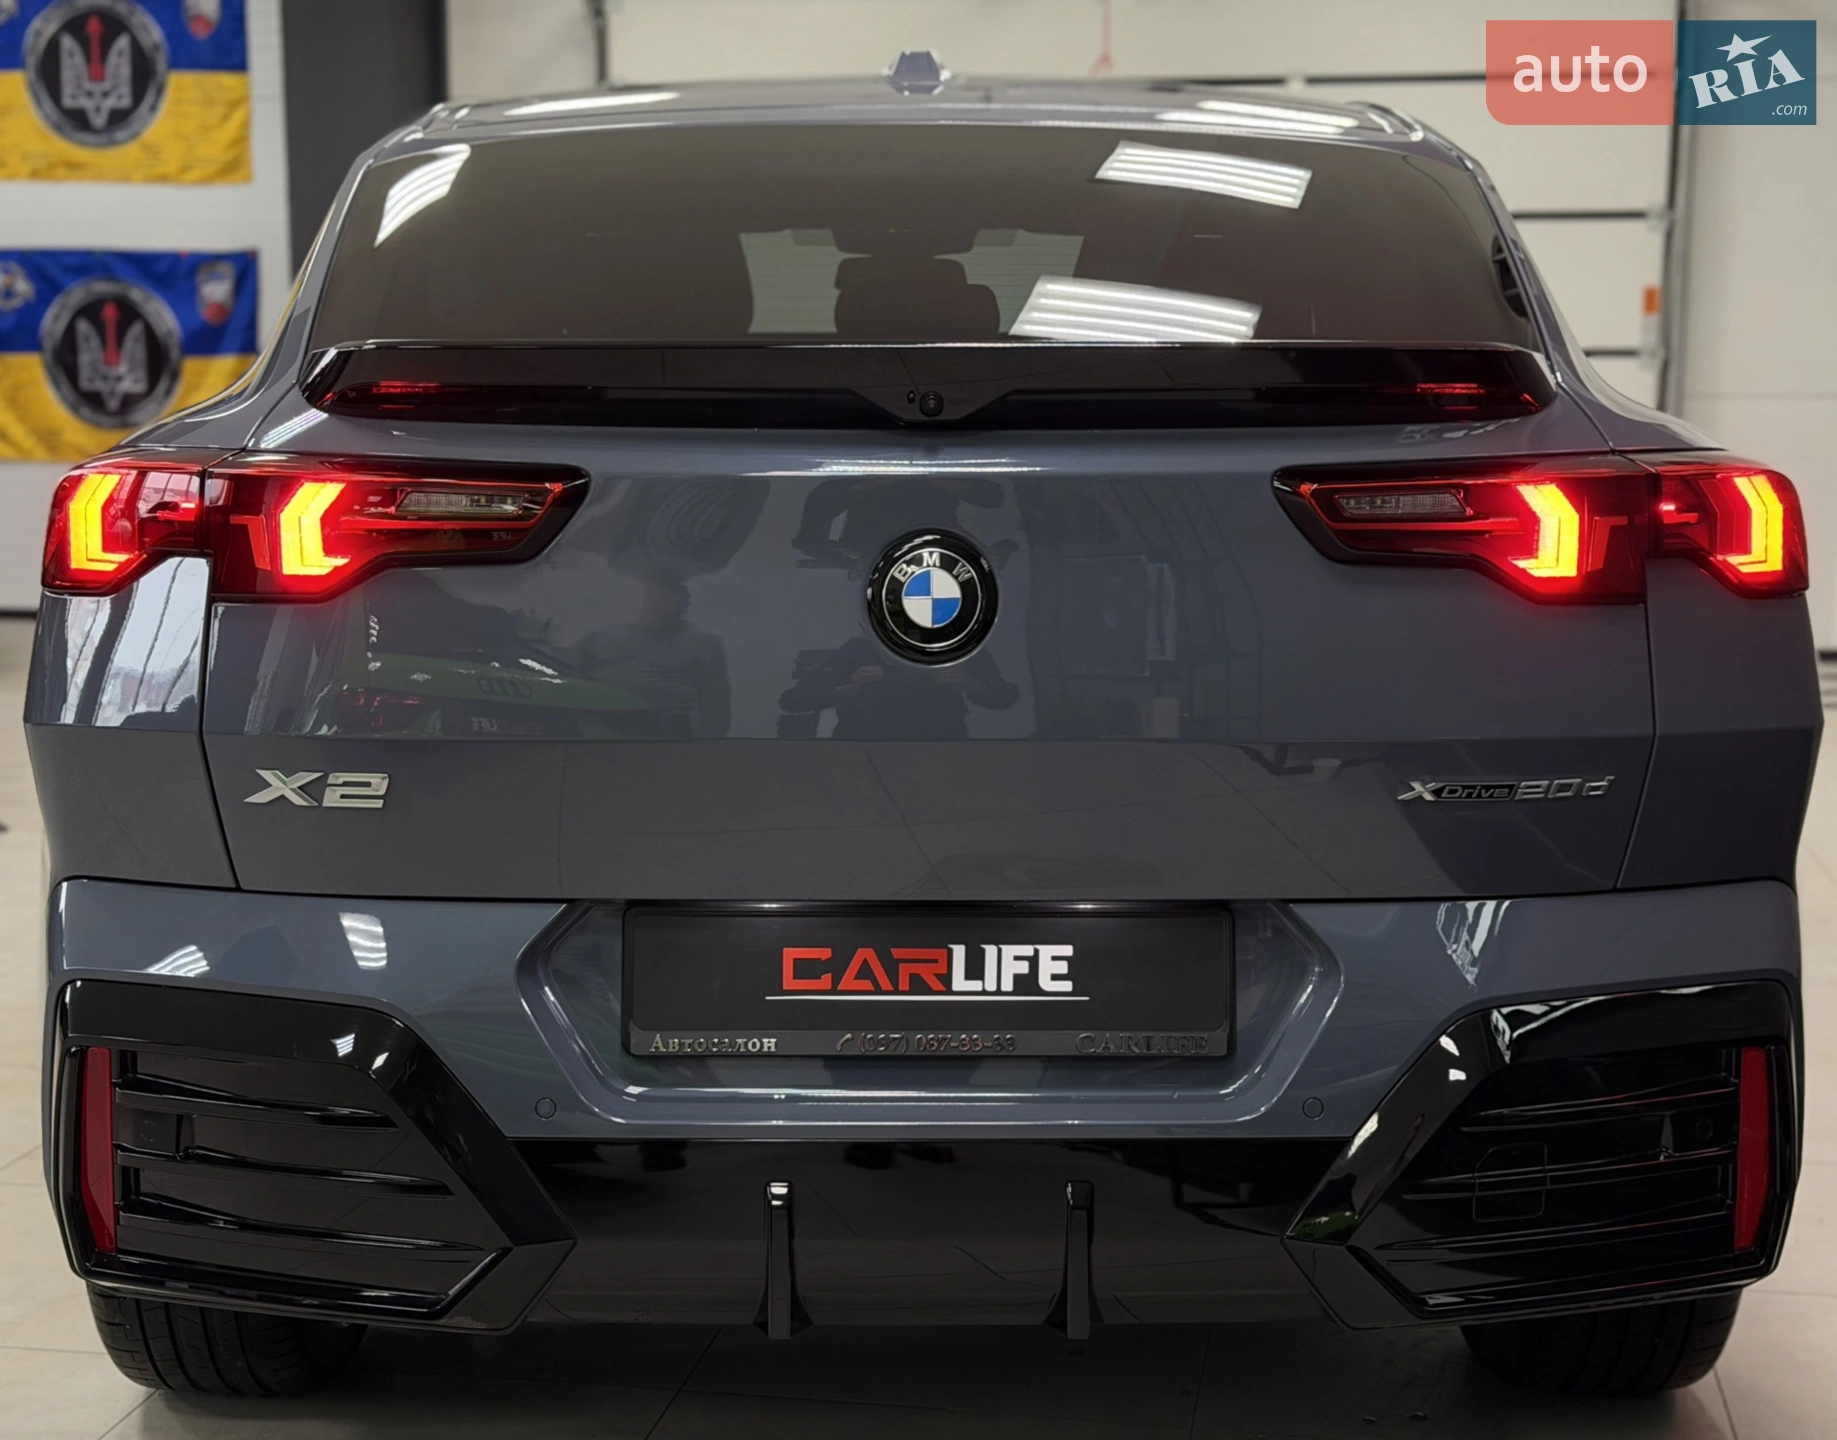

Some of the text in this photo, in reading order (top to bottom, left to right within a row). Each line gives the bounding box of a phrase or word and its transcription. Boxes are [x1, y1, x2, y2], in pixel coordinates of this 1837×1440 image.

[893, 551, 973, 583] BMW
[243, 768, 391, 809] X2
[782, 944, 1074, 993] CARLIFE
[648, 1033, 778, 1053] Автосалон
[1075, 1032, 1209, 1055] CARLIFE
